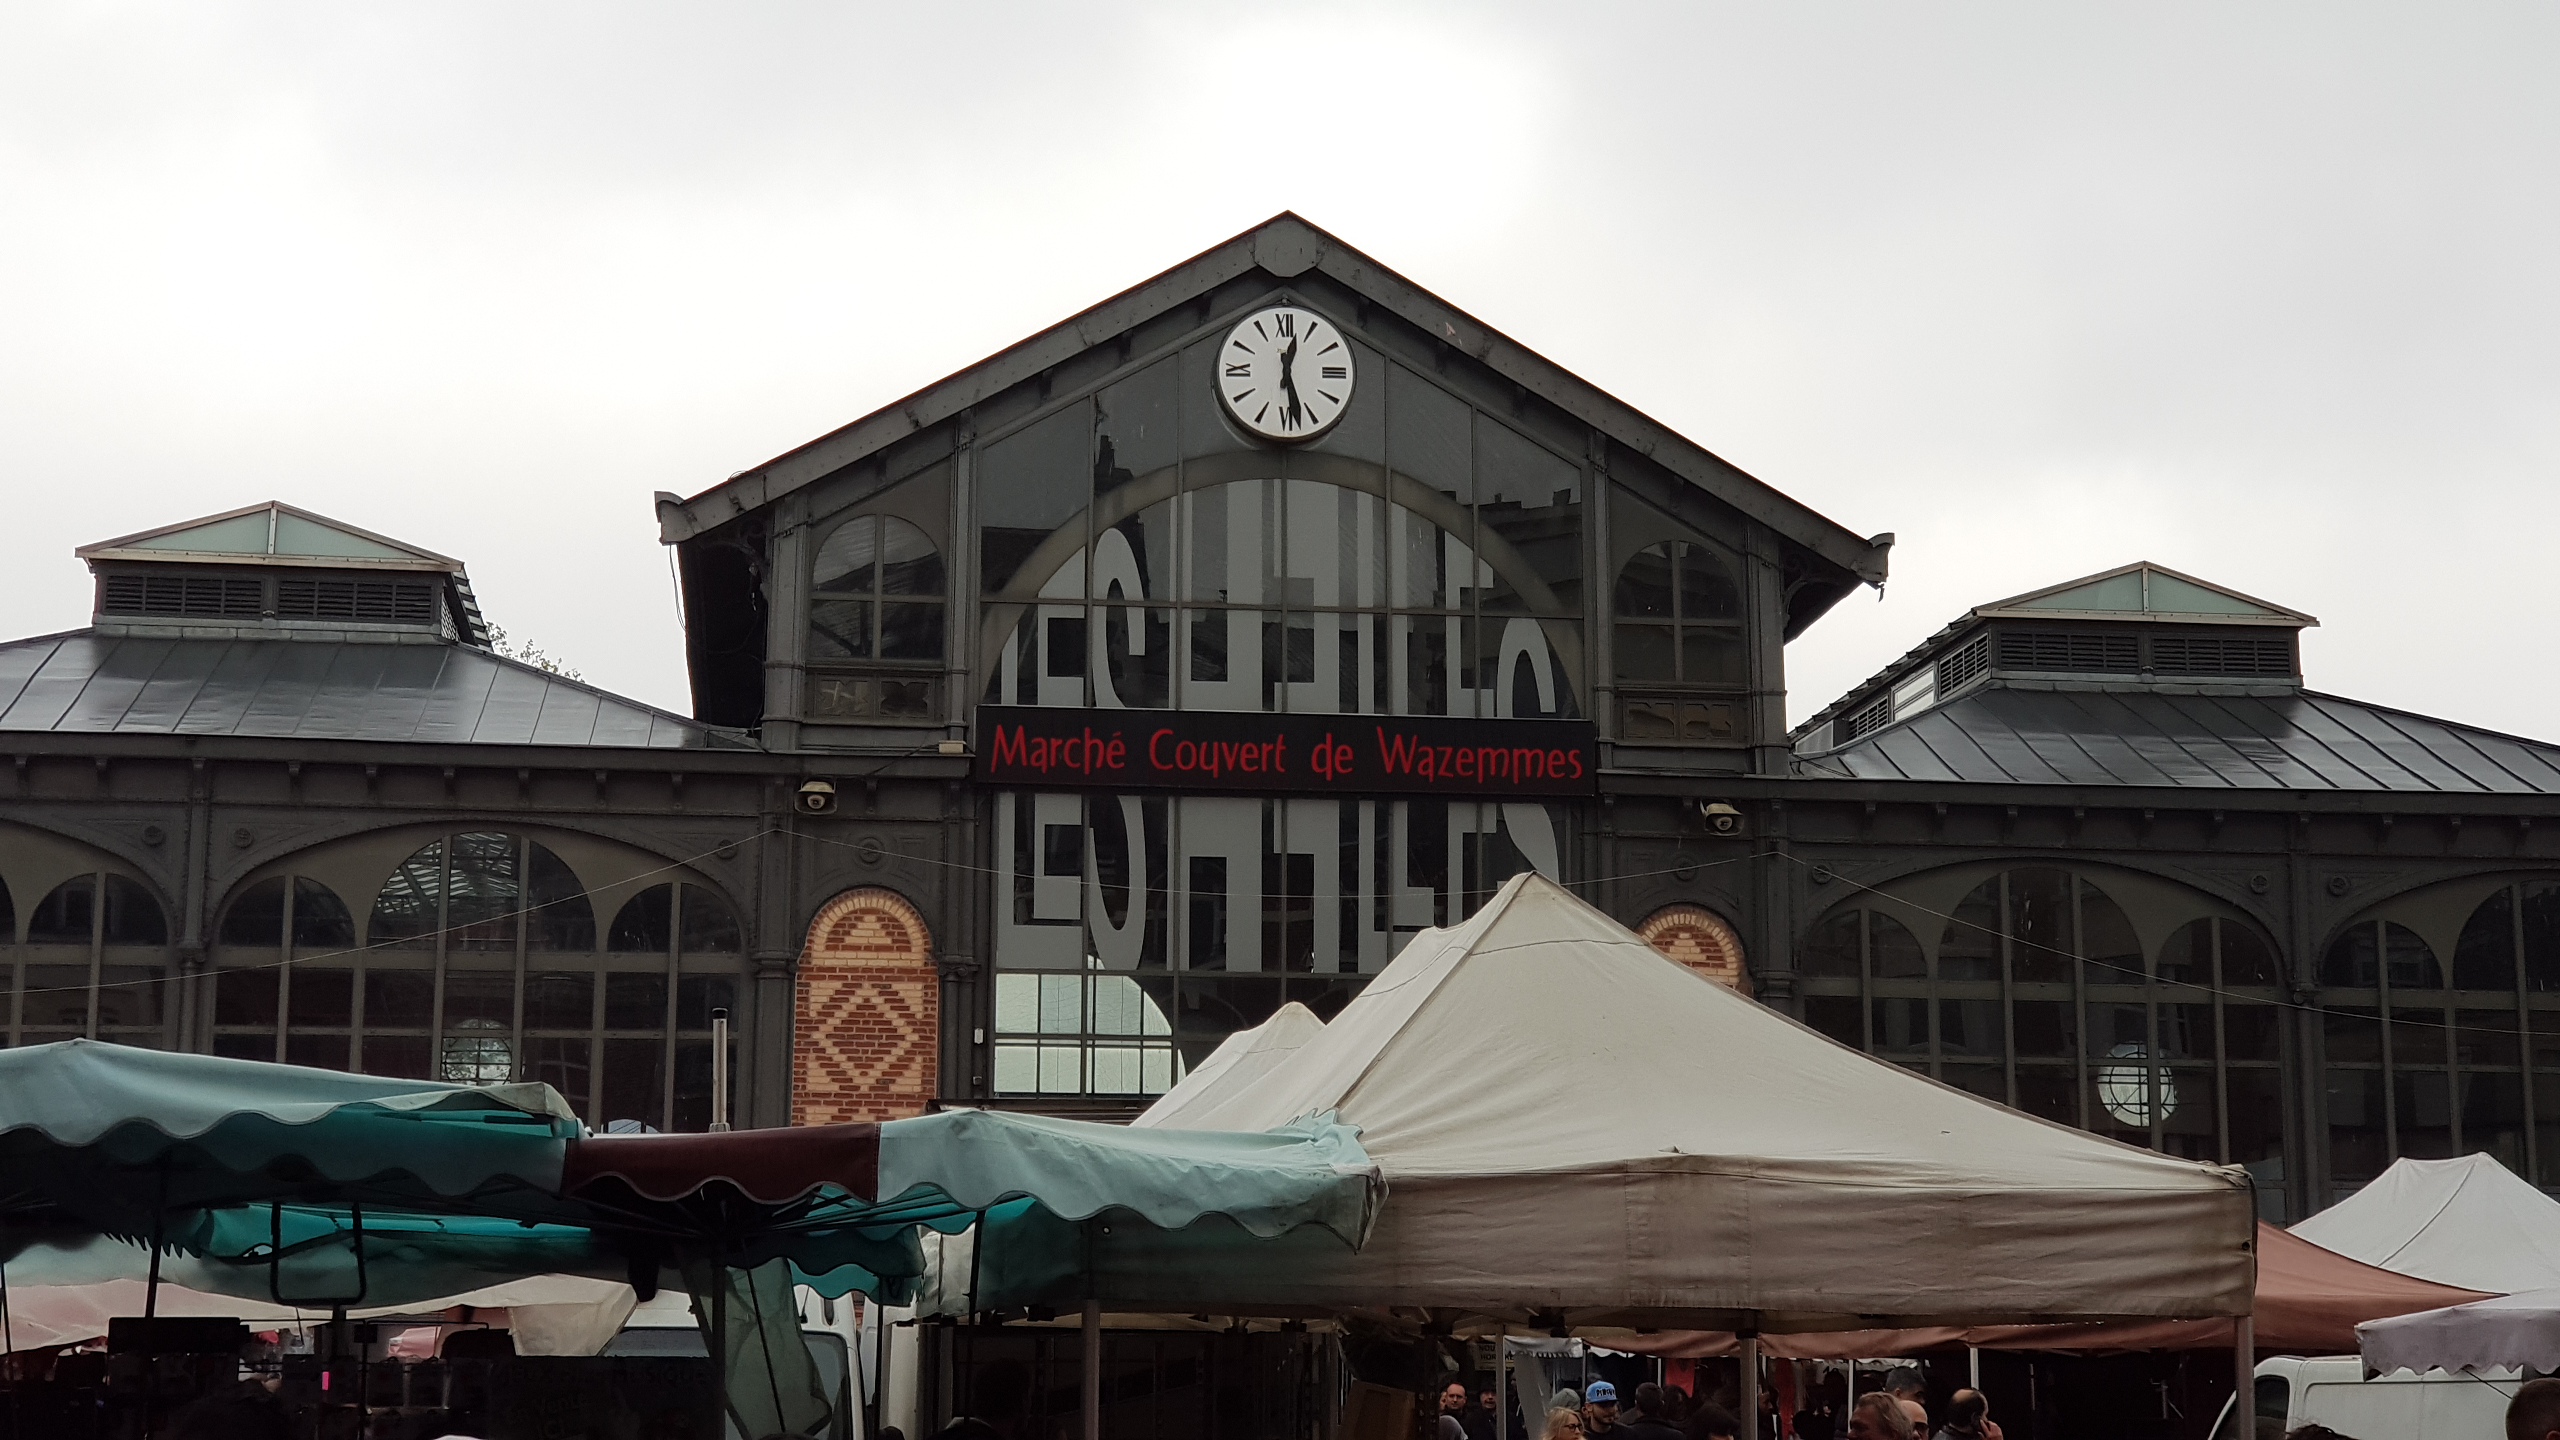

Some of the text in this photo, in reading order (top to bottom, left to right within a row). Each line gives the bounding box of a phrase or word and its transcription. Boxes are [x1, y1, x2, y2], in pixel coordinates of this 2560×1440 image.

[991, 724, 1583, 784] Marché Couvert de Wazemmes
